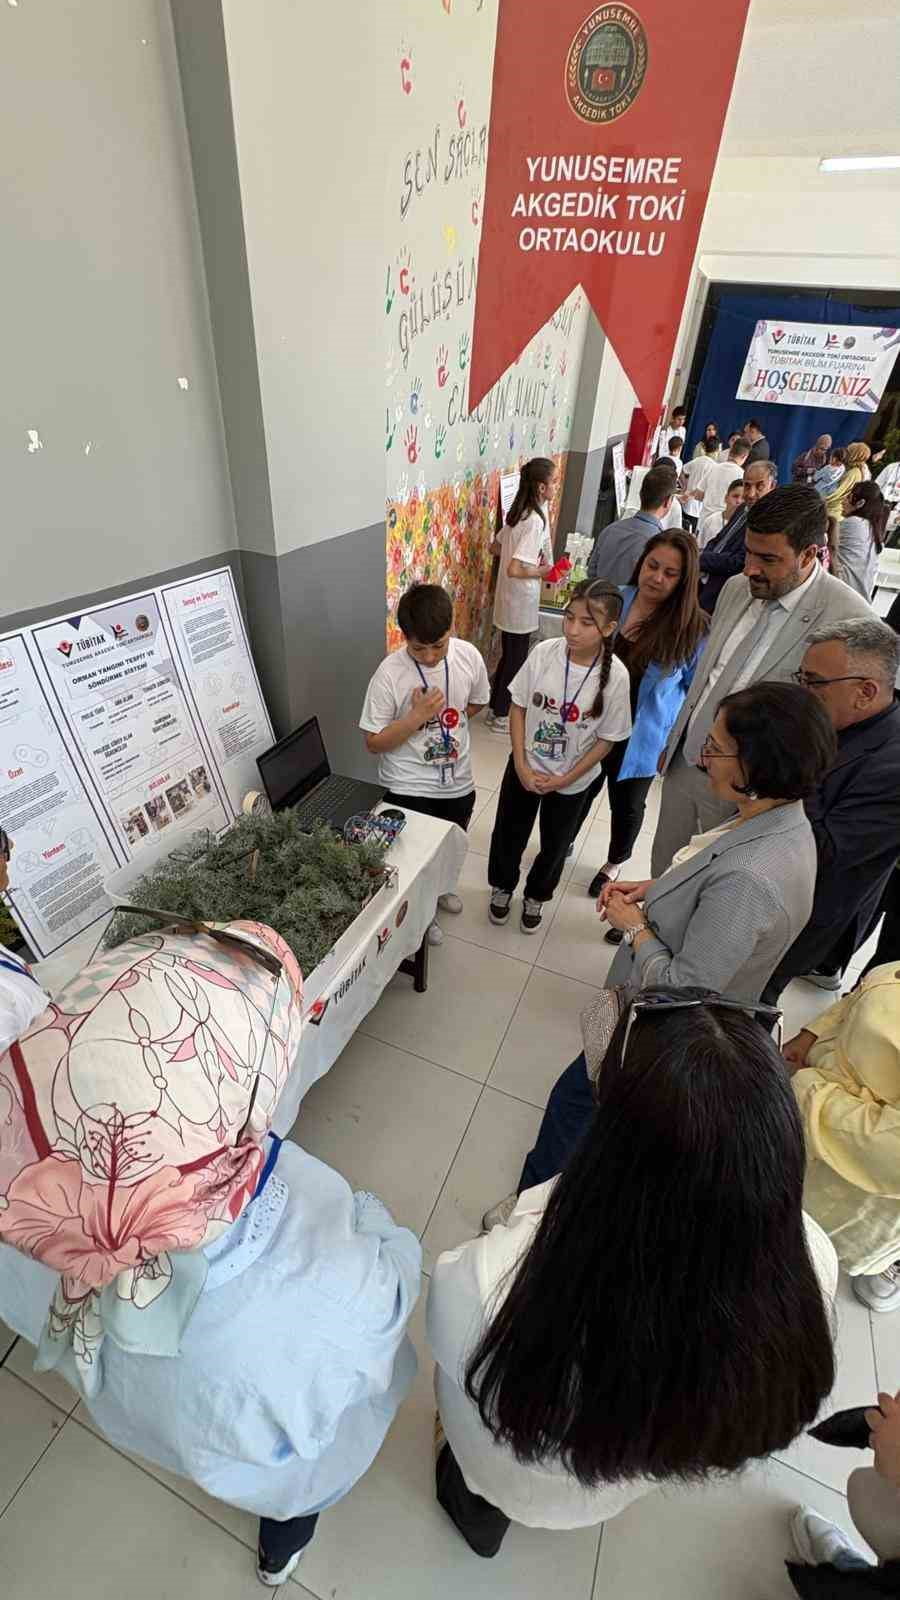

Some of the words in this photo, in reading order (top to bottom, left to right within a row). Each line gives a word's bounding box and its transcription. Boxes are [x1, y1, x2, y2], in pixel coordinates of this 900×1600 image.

[400, 123, 440, 218] SEN
[526, 155, 682, 184] YUNUSEMRE
[511, 187, 620, 219] AKGEDİK
[626, 188, 687, 221] TOKİ
[518, 227, 666, 256] ORTAOKULU
[786, 332, 817, 346] TÜBİTAK
[753, 368, 872, 398] HOŞGELDİNİZ
[77, 633, 106, 651] TÜBİTAK
[72, 670, 97, 684] ORMAN
[125, 652, 146, 665] TESPİT
[146, 649, 154, 657] VE
[88, 671, 123, 690] SÖNDÜRME
[124, 661, 148, 676] SİSTEMİ
[8, 767, 24, 780] Özet
[334, 954, 368, 1004] TÜBİTAK
